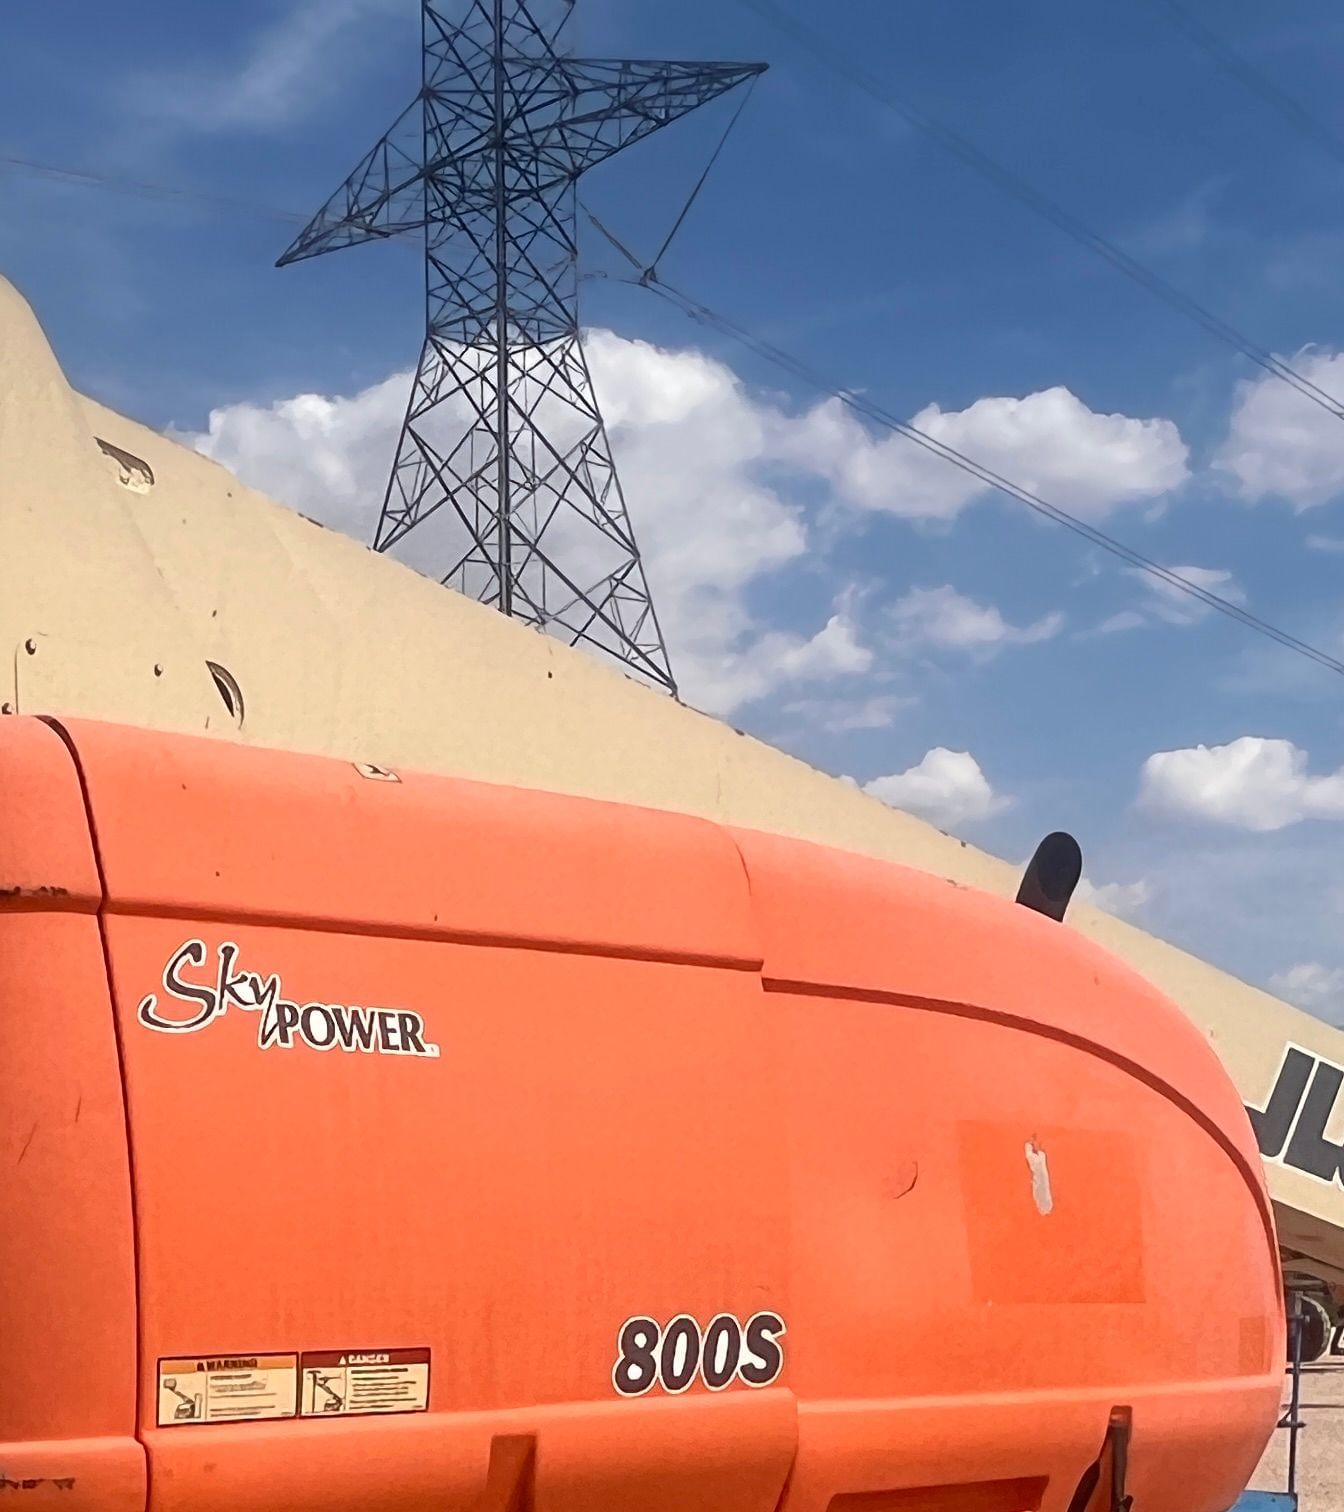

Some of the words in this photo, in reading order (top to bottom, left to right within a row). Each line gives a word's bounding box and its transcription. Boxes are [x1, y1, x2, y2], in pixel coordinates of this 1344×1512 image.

[139, 941, 278, 1047] Sky
[274, 1002, 427, 1054] POWER
[614, 1313, 784, 1394] 800S
